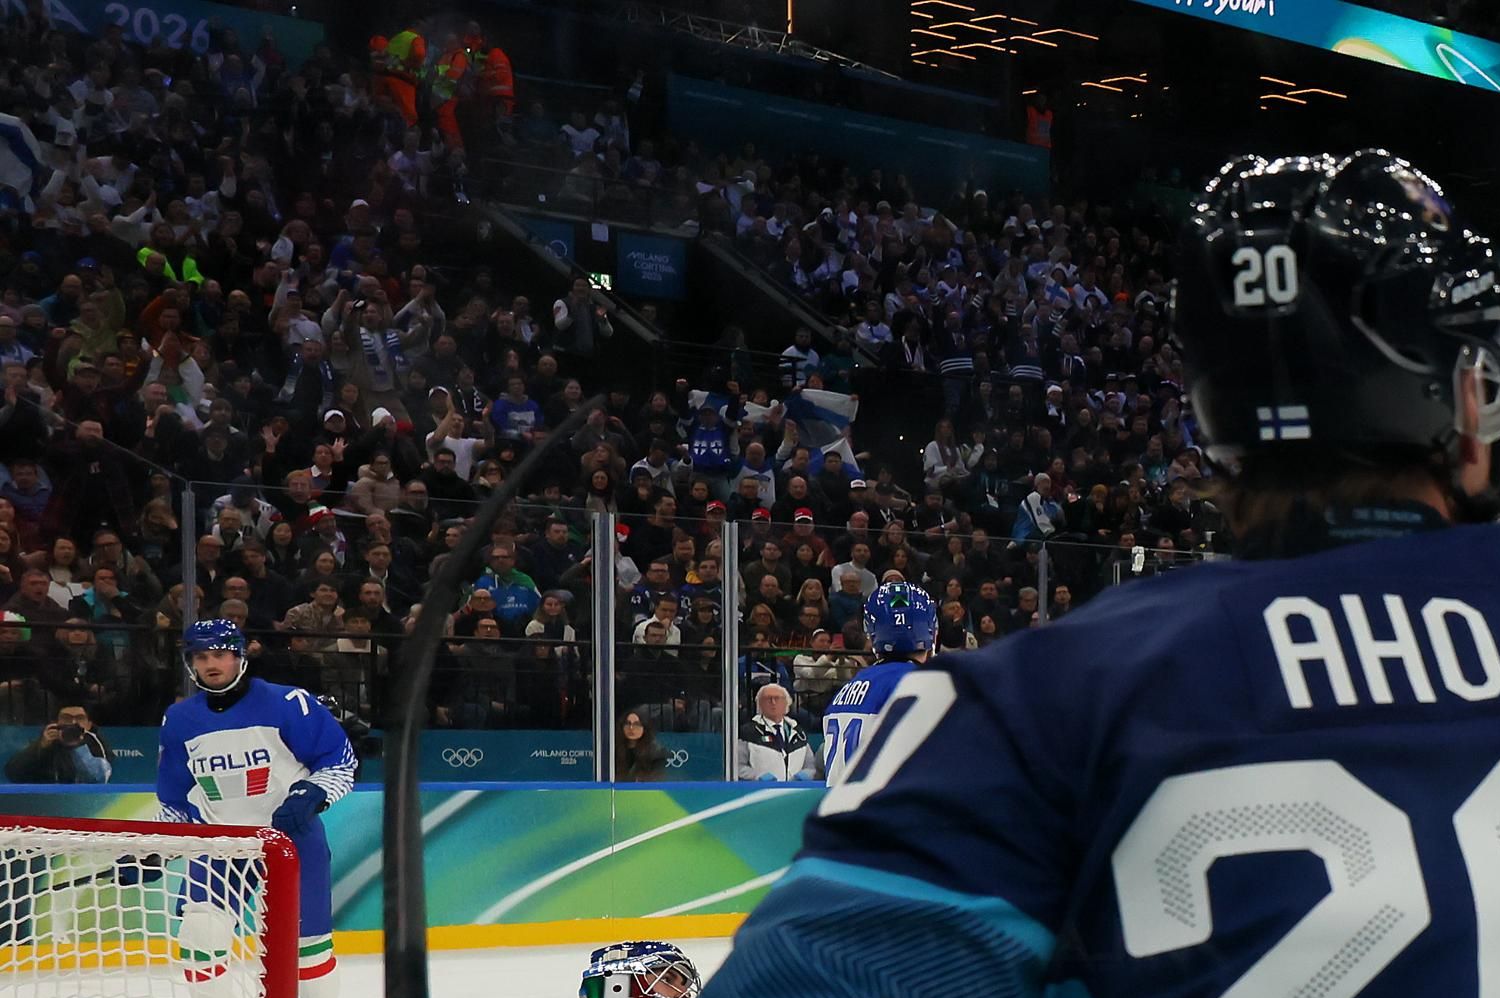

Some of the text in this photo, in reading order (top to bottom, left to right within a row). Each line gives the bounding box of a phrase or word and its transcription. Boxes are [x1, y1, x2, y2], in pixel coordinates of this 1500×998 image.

[626, 251, 670, 265] MILANO
[1231, 244, 1298, 306] 20
[894, 613, 905, 625] 21
[530, 749, 568, 758] MILANO
[192, 748, 271, 775] ITALIA
